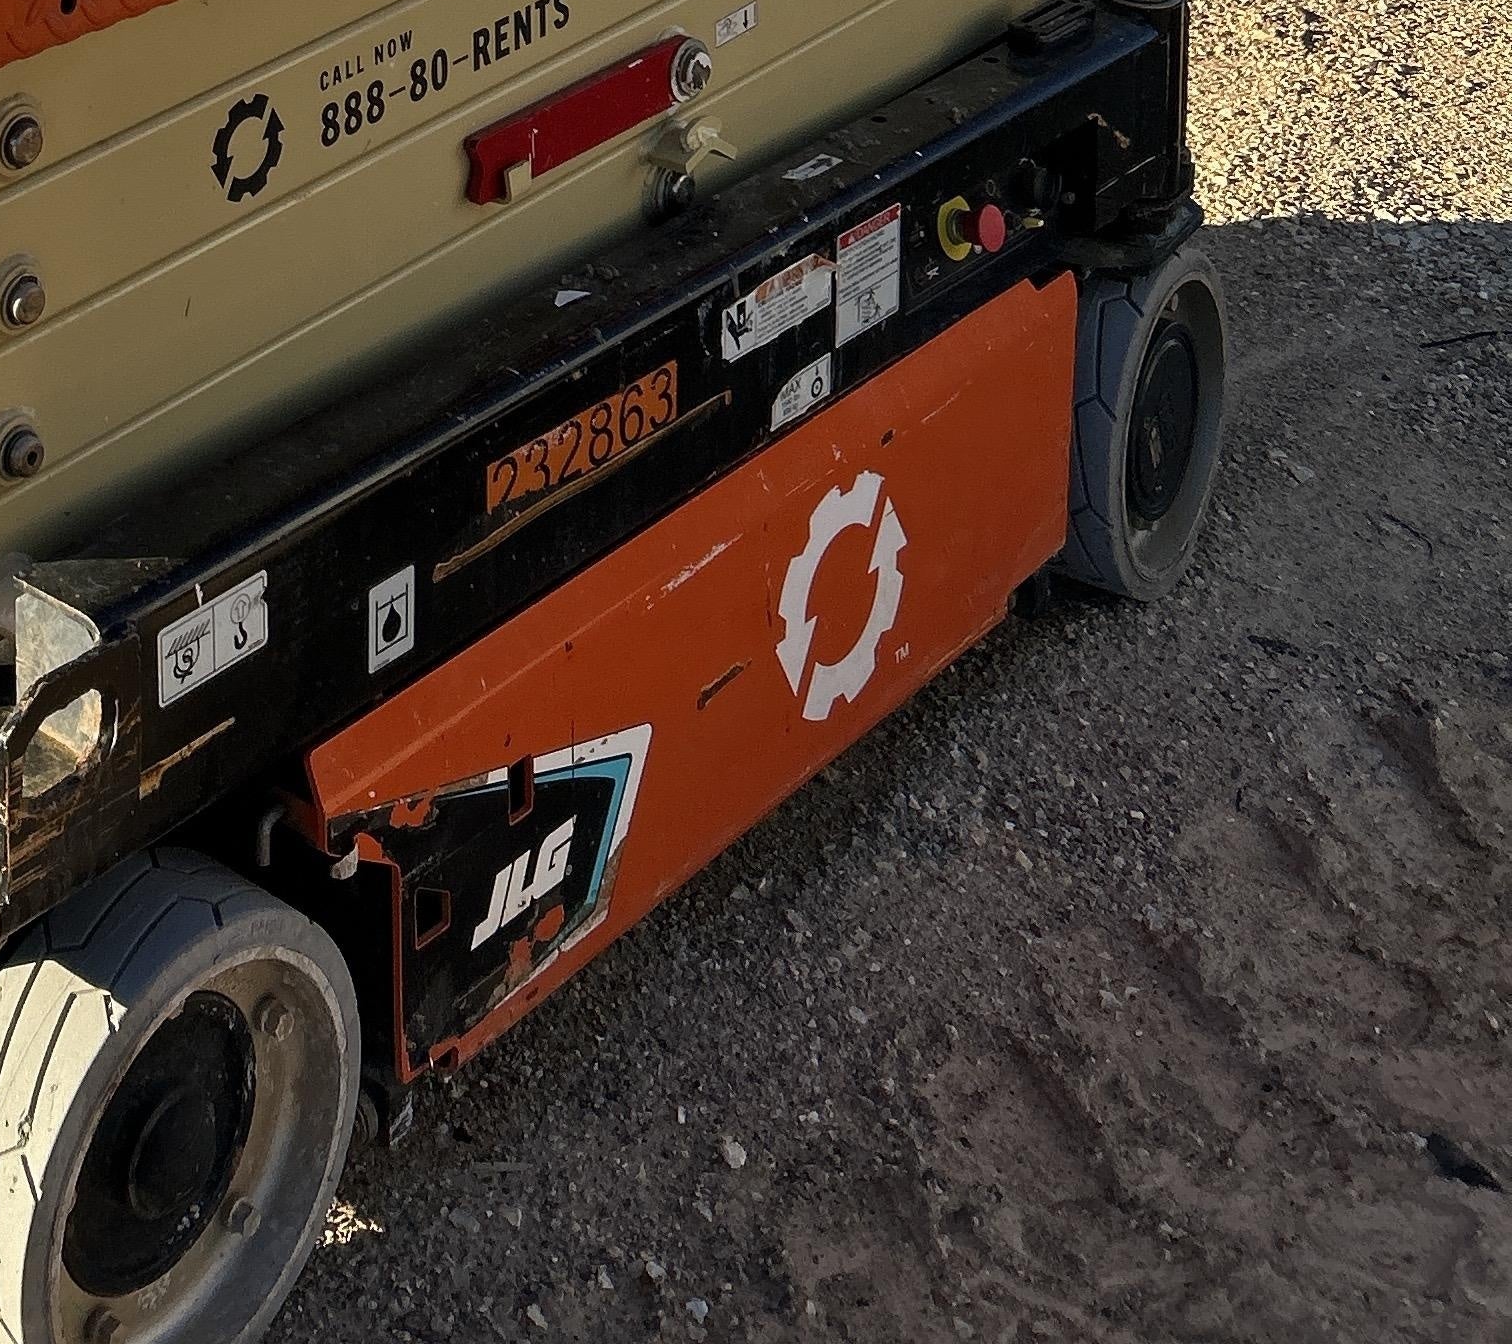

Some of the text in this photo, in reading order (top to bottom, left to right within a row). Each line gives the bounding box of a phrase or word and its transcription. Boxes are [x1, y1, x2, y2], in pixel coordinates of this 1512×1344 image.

[319, 29, 413, 92] CALL NOW
[492, 367, 674, 502] 232863
[470, 813, 578, 952] JLG
